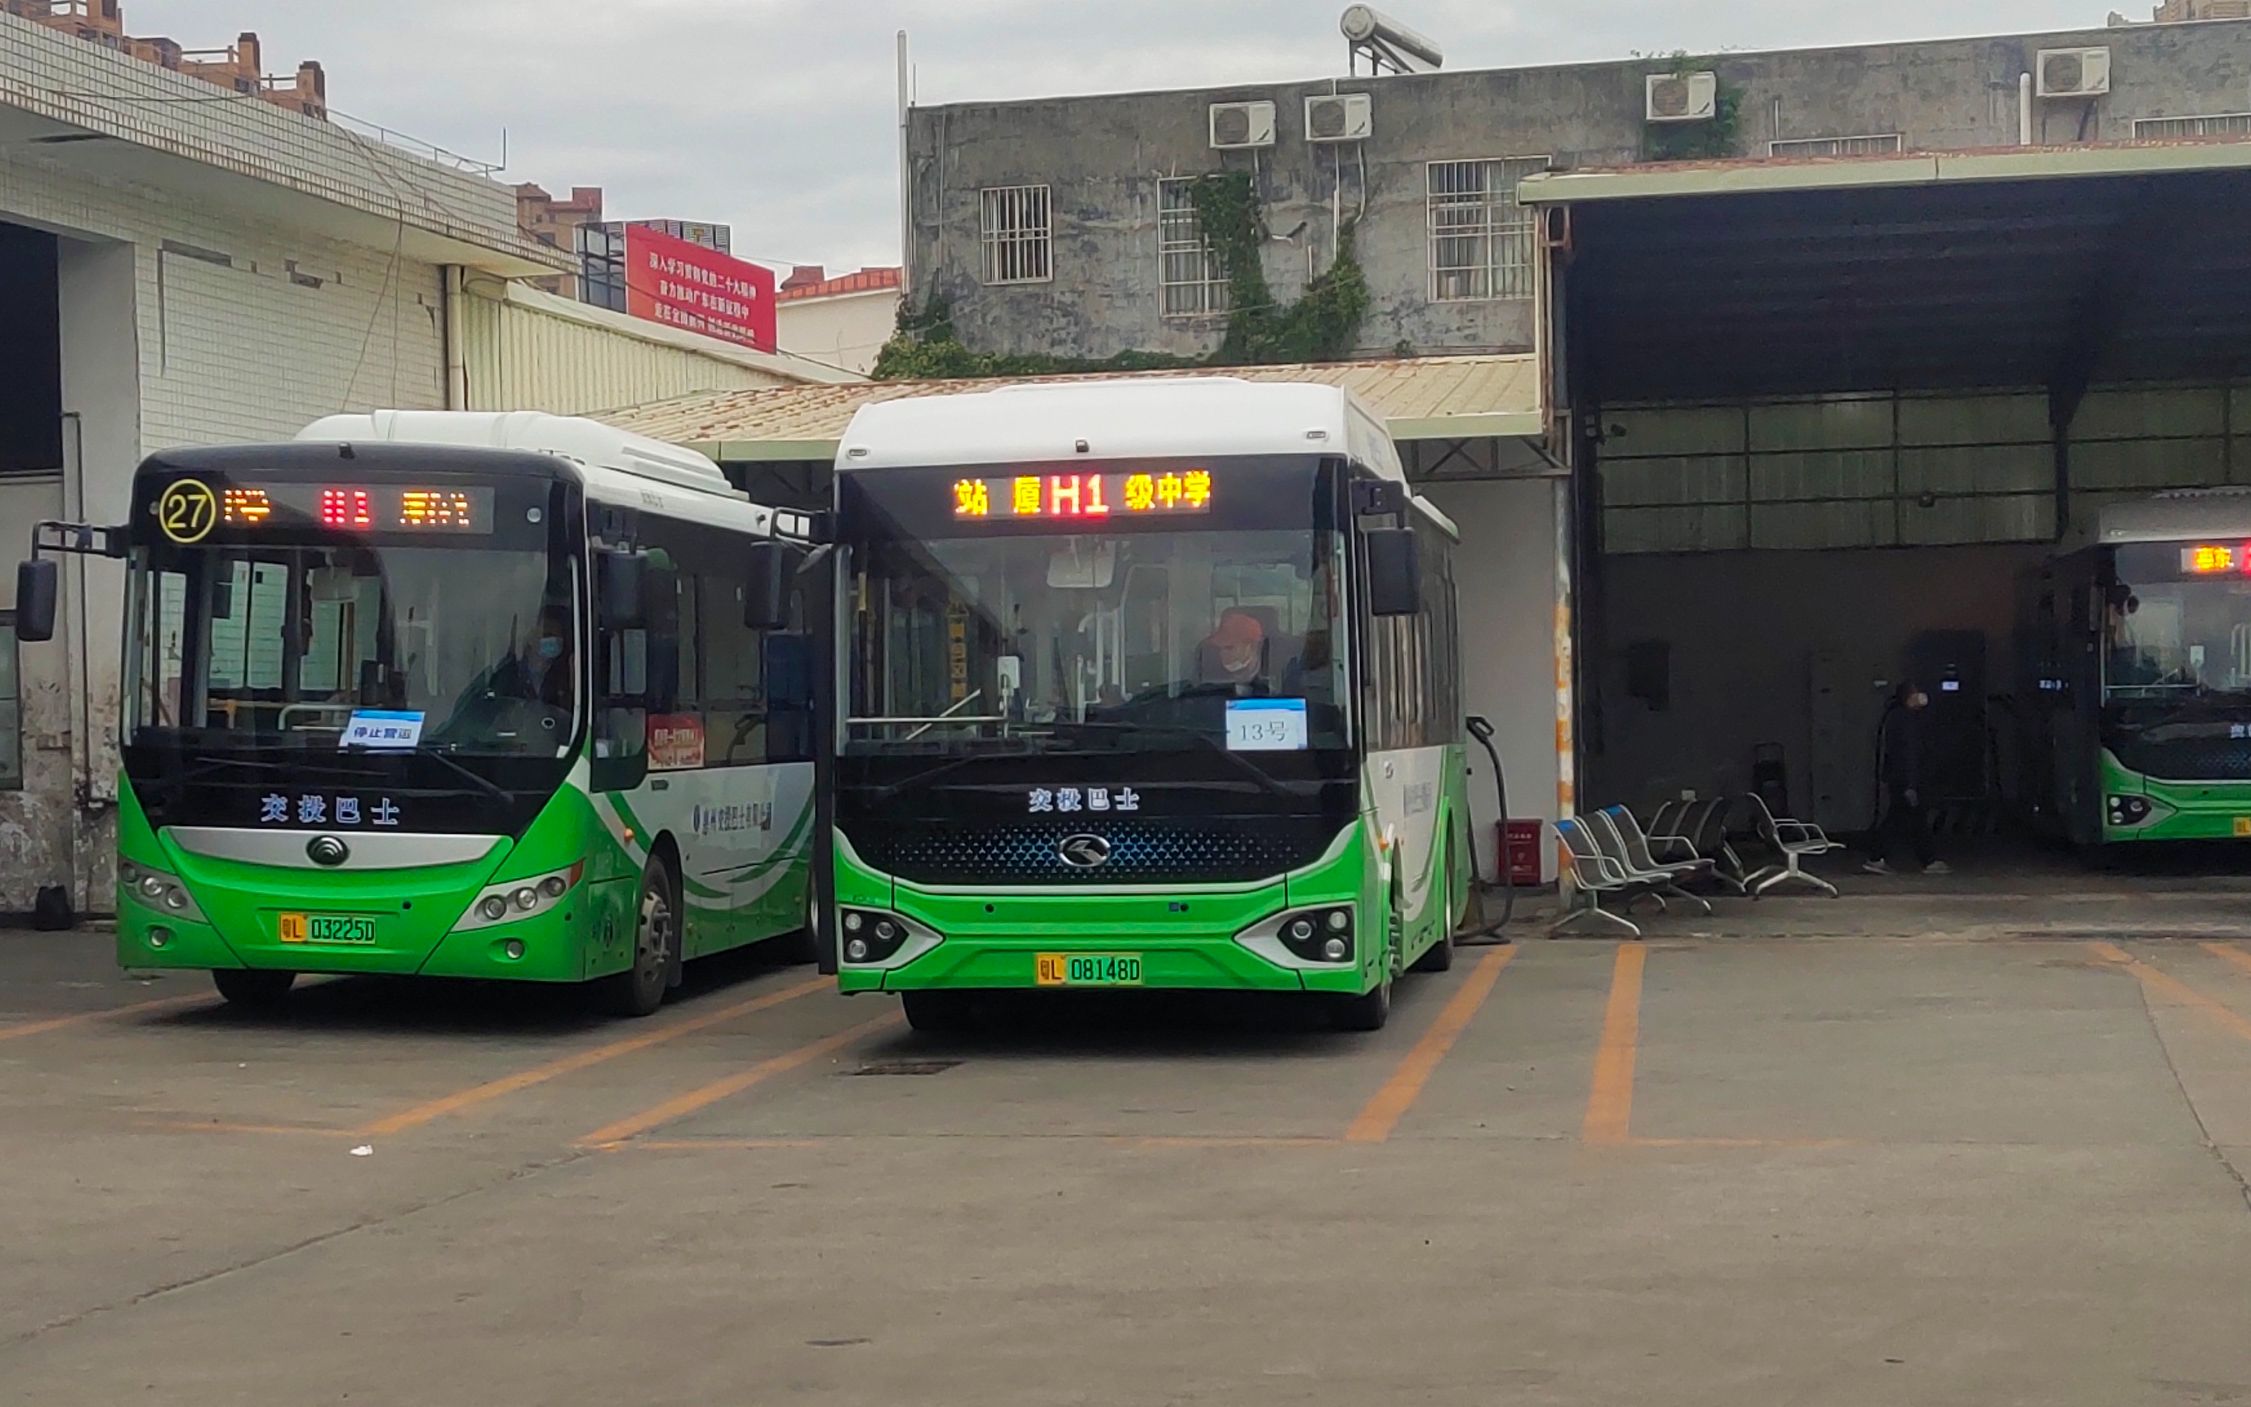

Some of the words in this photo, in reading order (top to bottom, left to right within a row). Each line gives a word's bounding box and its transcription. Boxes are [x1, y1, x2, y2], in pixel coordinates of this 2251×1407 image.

[954, 478, 988, 516] 站
[1050, 474, 1110, 516] H1
[1125, 470, 1212, 510] 级中学
[167, 494, 207, 529] 27
[353, 726, 412, 741] 停止营运
[1239, 719, 1289, 743] 13号
[260, 792, 401, 826] 交投巴士
[1028, 786, 1141, 812] 交投巴士
[311, 916, 375, 942] 03225D
[1071, 956, 1140, 982] 08148D
